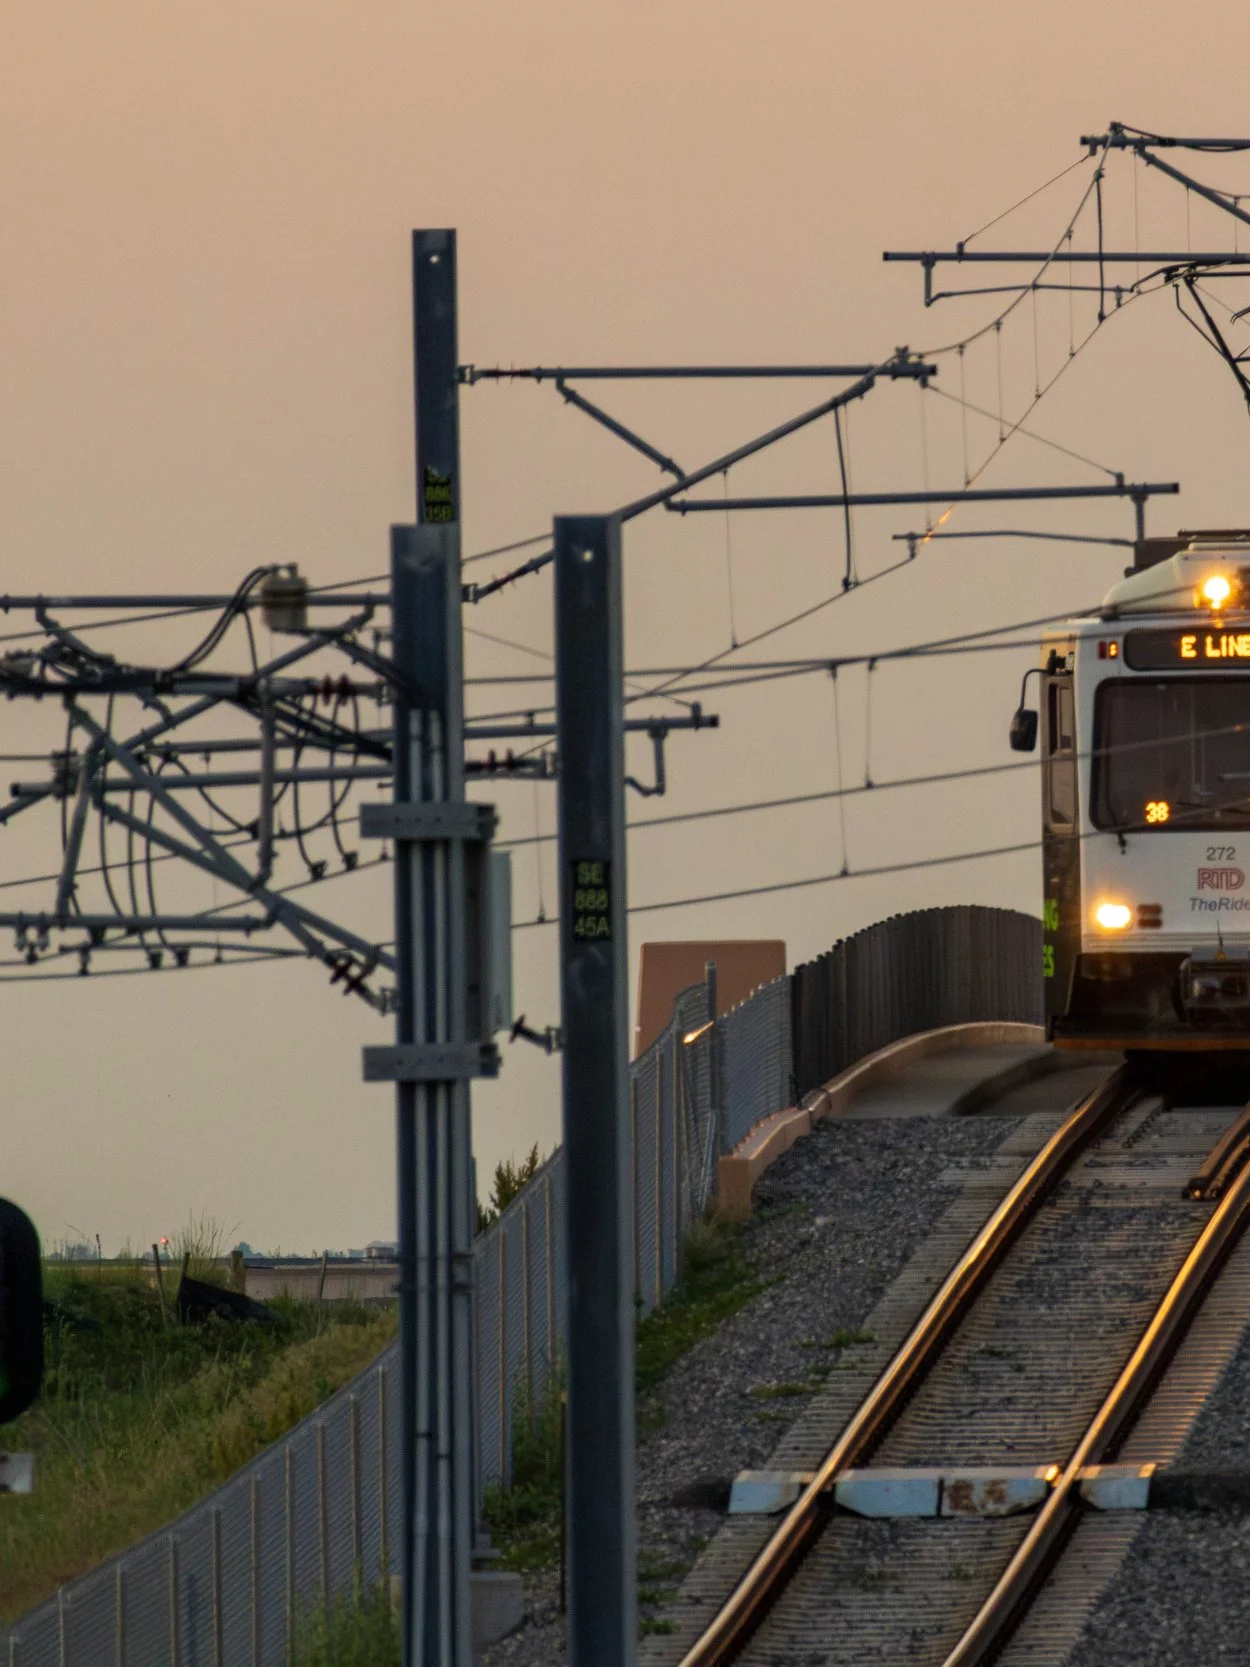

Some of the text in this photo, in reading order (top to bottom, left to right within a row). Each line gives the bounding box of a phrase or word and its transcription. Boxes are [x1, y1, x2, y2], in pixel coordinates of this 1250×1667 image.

[1181, 635, 1197, 657] E
[1145, 801, 1169, 823] 38
[1206, 846, 1236, 861] 272
[578, 863, 604, 885] SE
[1198, 867, 1245, 890] RTD
